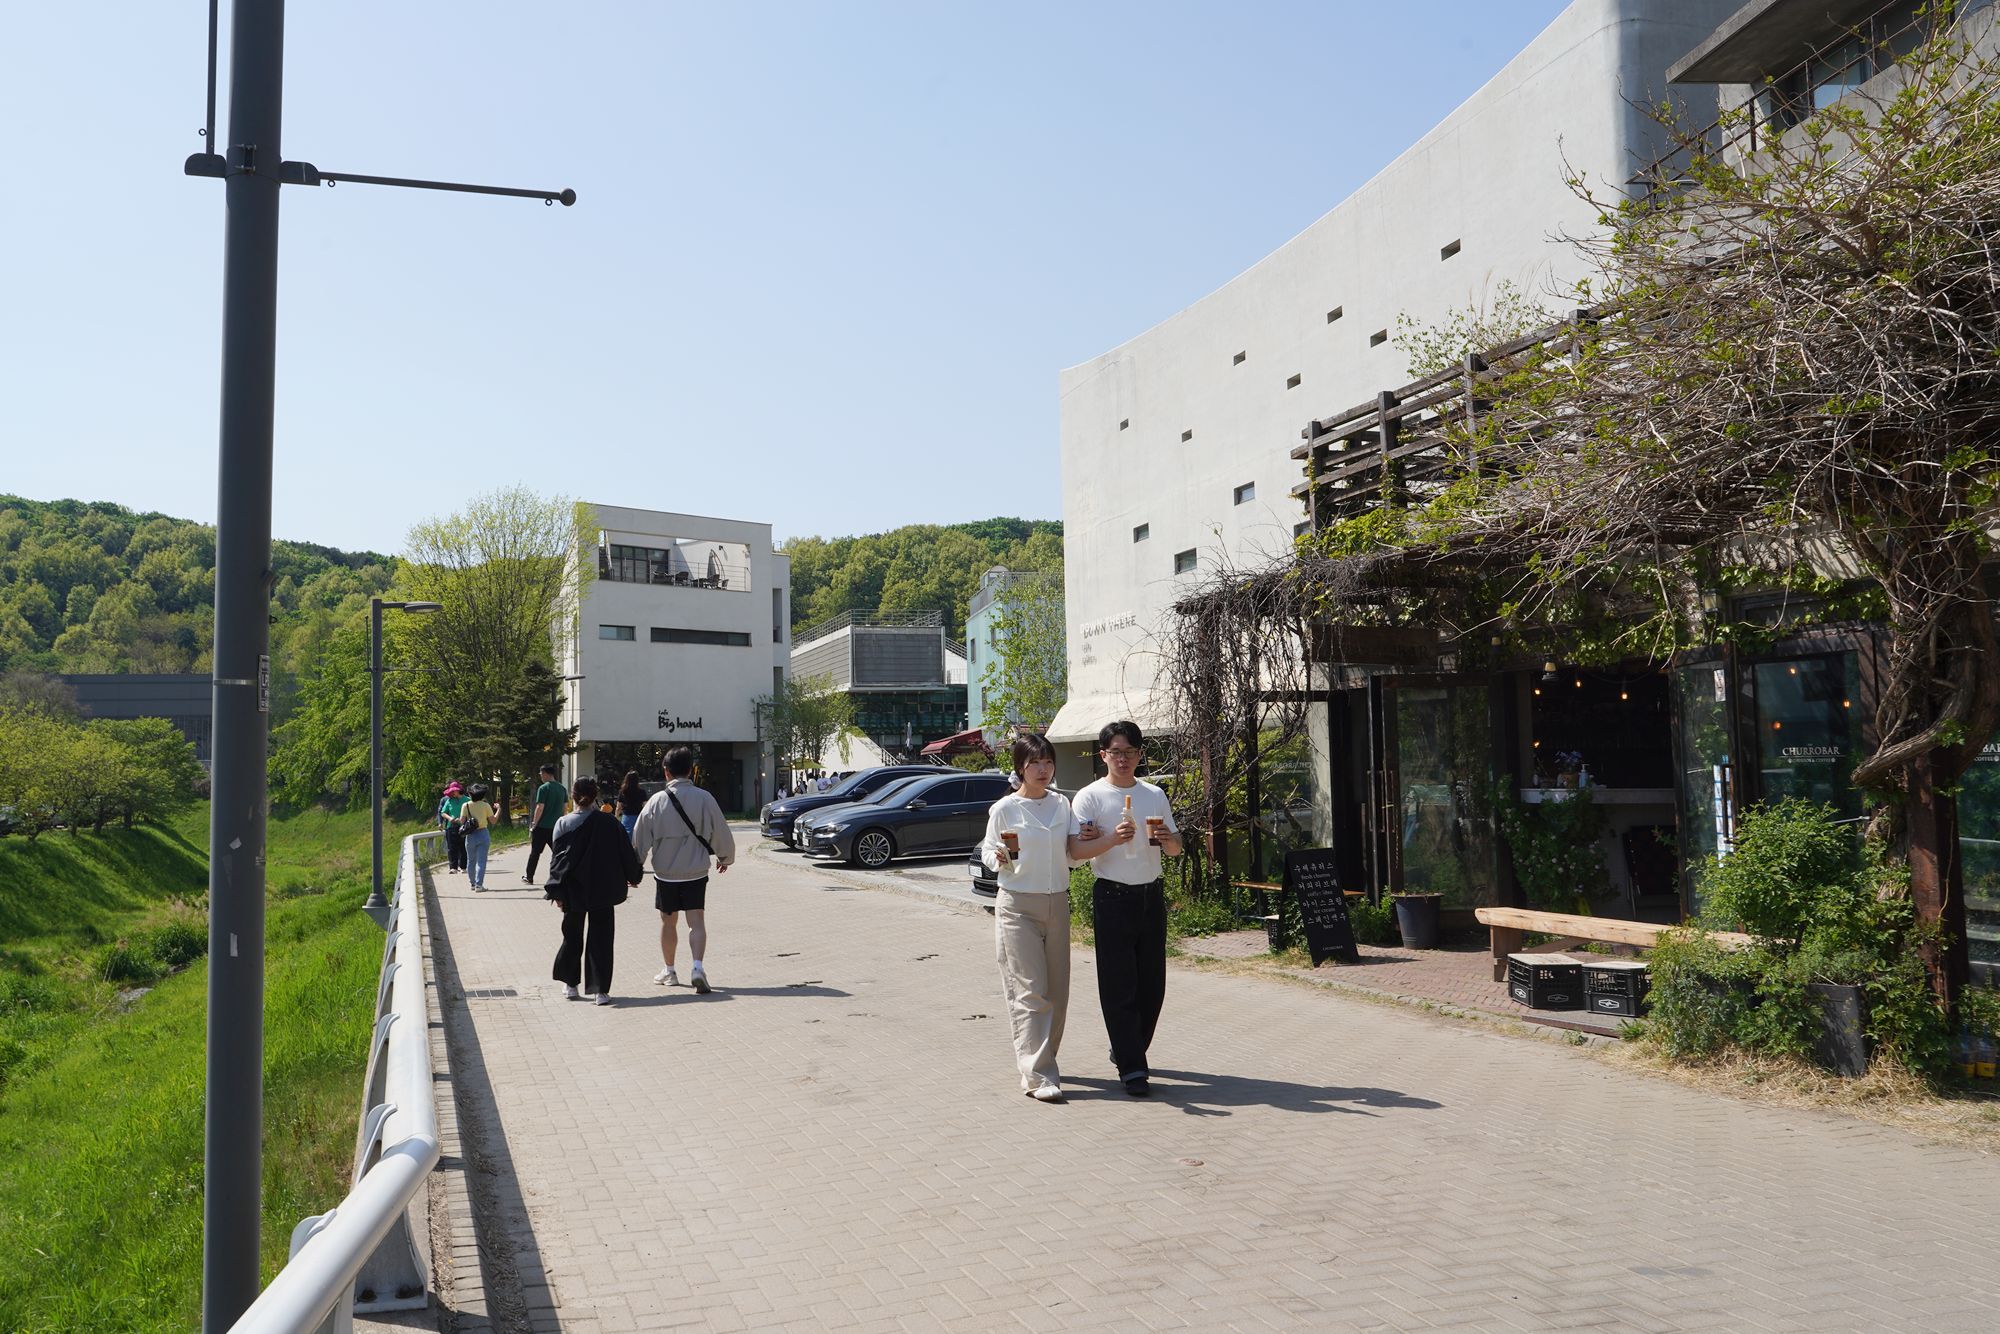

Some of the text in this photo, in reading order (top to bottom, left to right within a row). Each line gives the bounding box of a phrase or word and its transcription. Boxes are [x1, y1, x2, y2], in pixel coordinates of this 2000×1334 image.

[658, 715, 703, 733] Big hand
[1782, 746, 1840, 756] CHURROBAR
[1302, 897, 1342, 908] 아이스크림
